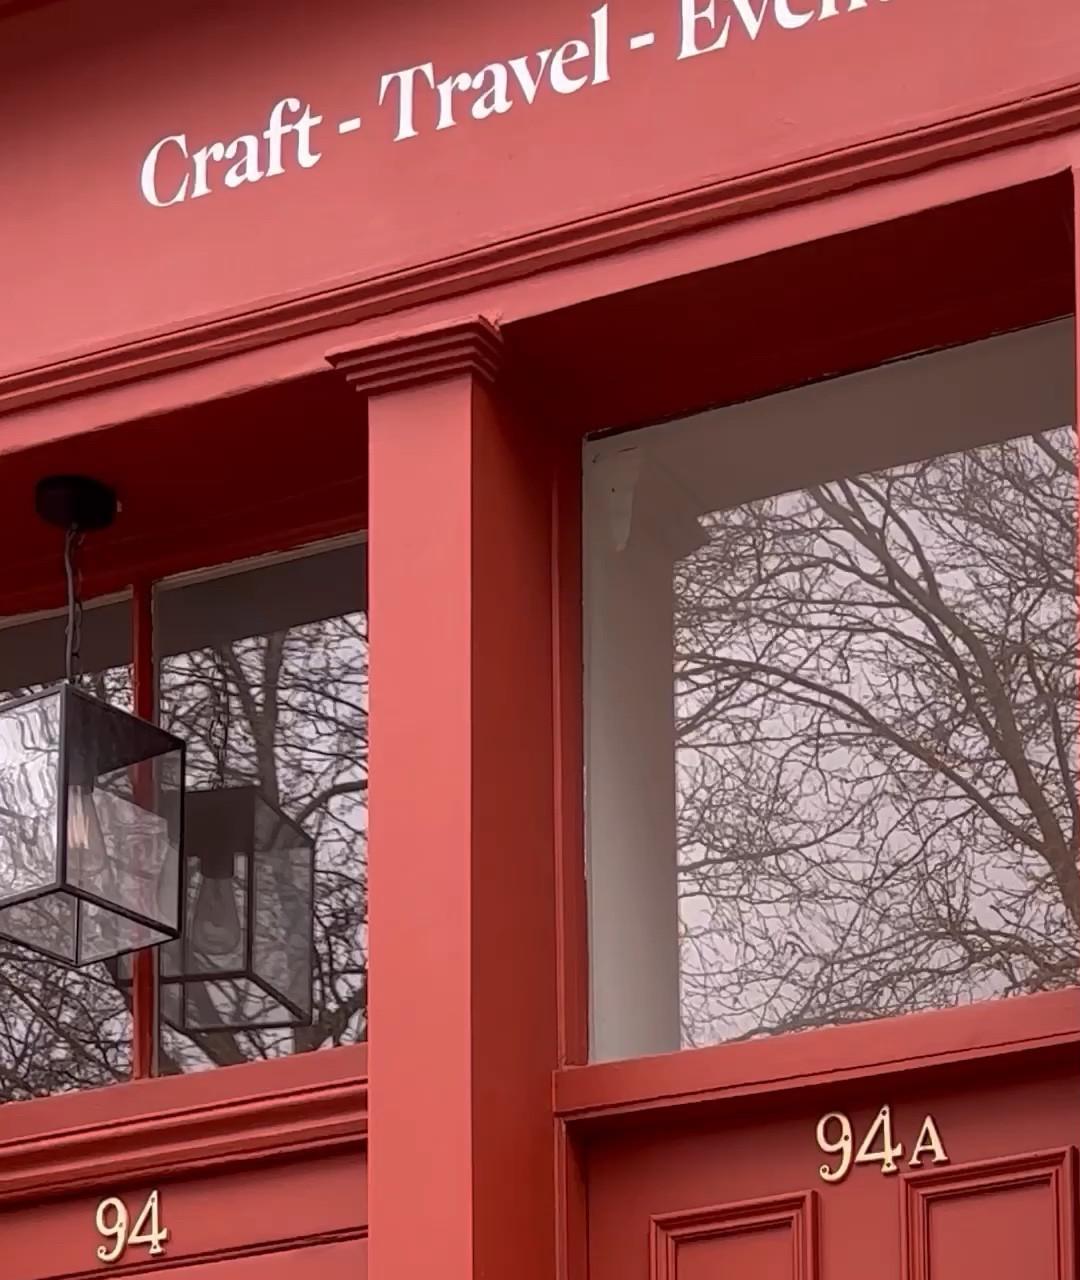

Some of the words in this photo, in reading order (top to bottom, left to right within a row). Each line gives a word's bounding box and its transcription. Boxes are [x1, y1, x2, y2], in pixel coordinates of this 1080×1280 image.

[141, 97, 323, 207] Craft
[378, 3, 611, 142] Travel
[816, 1104, 949, 1182] 94A
[95, 1189, 168, 1261] 94
